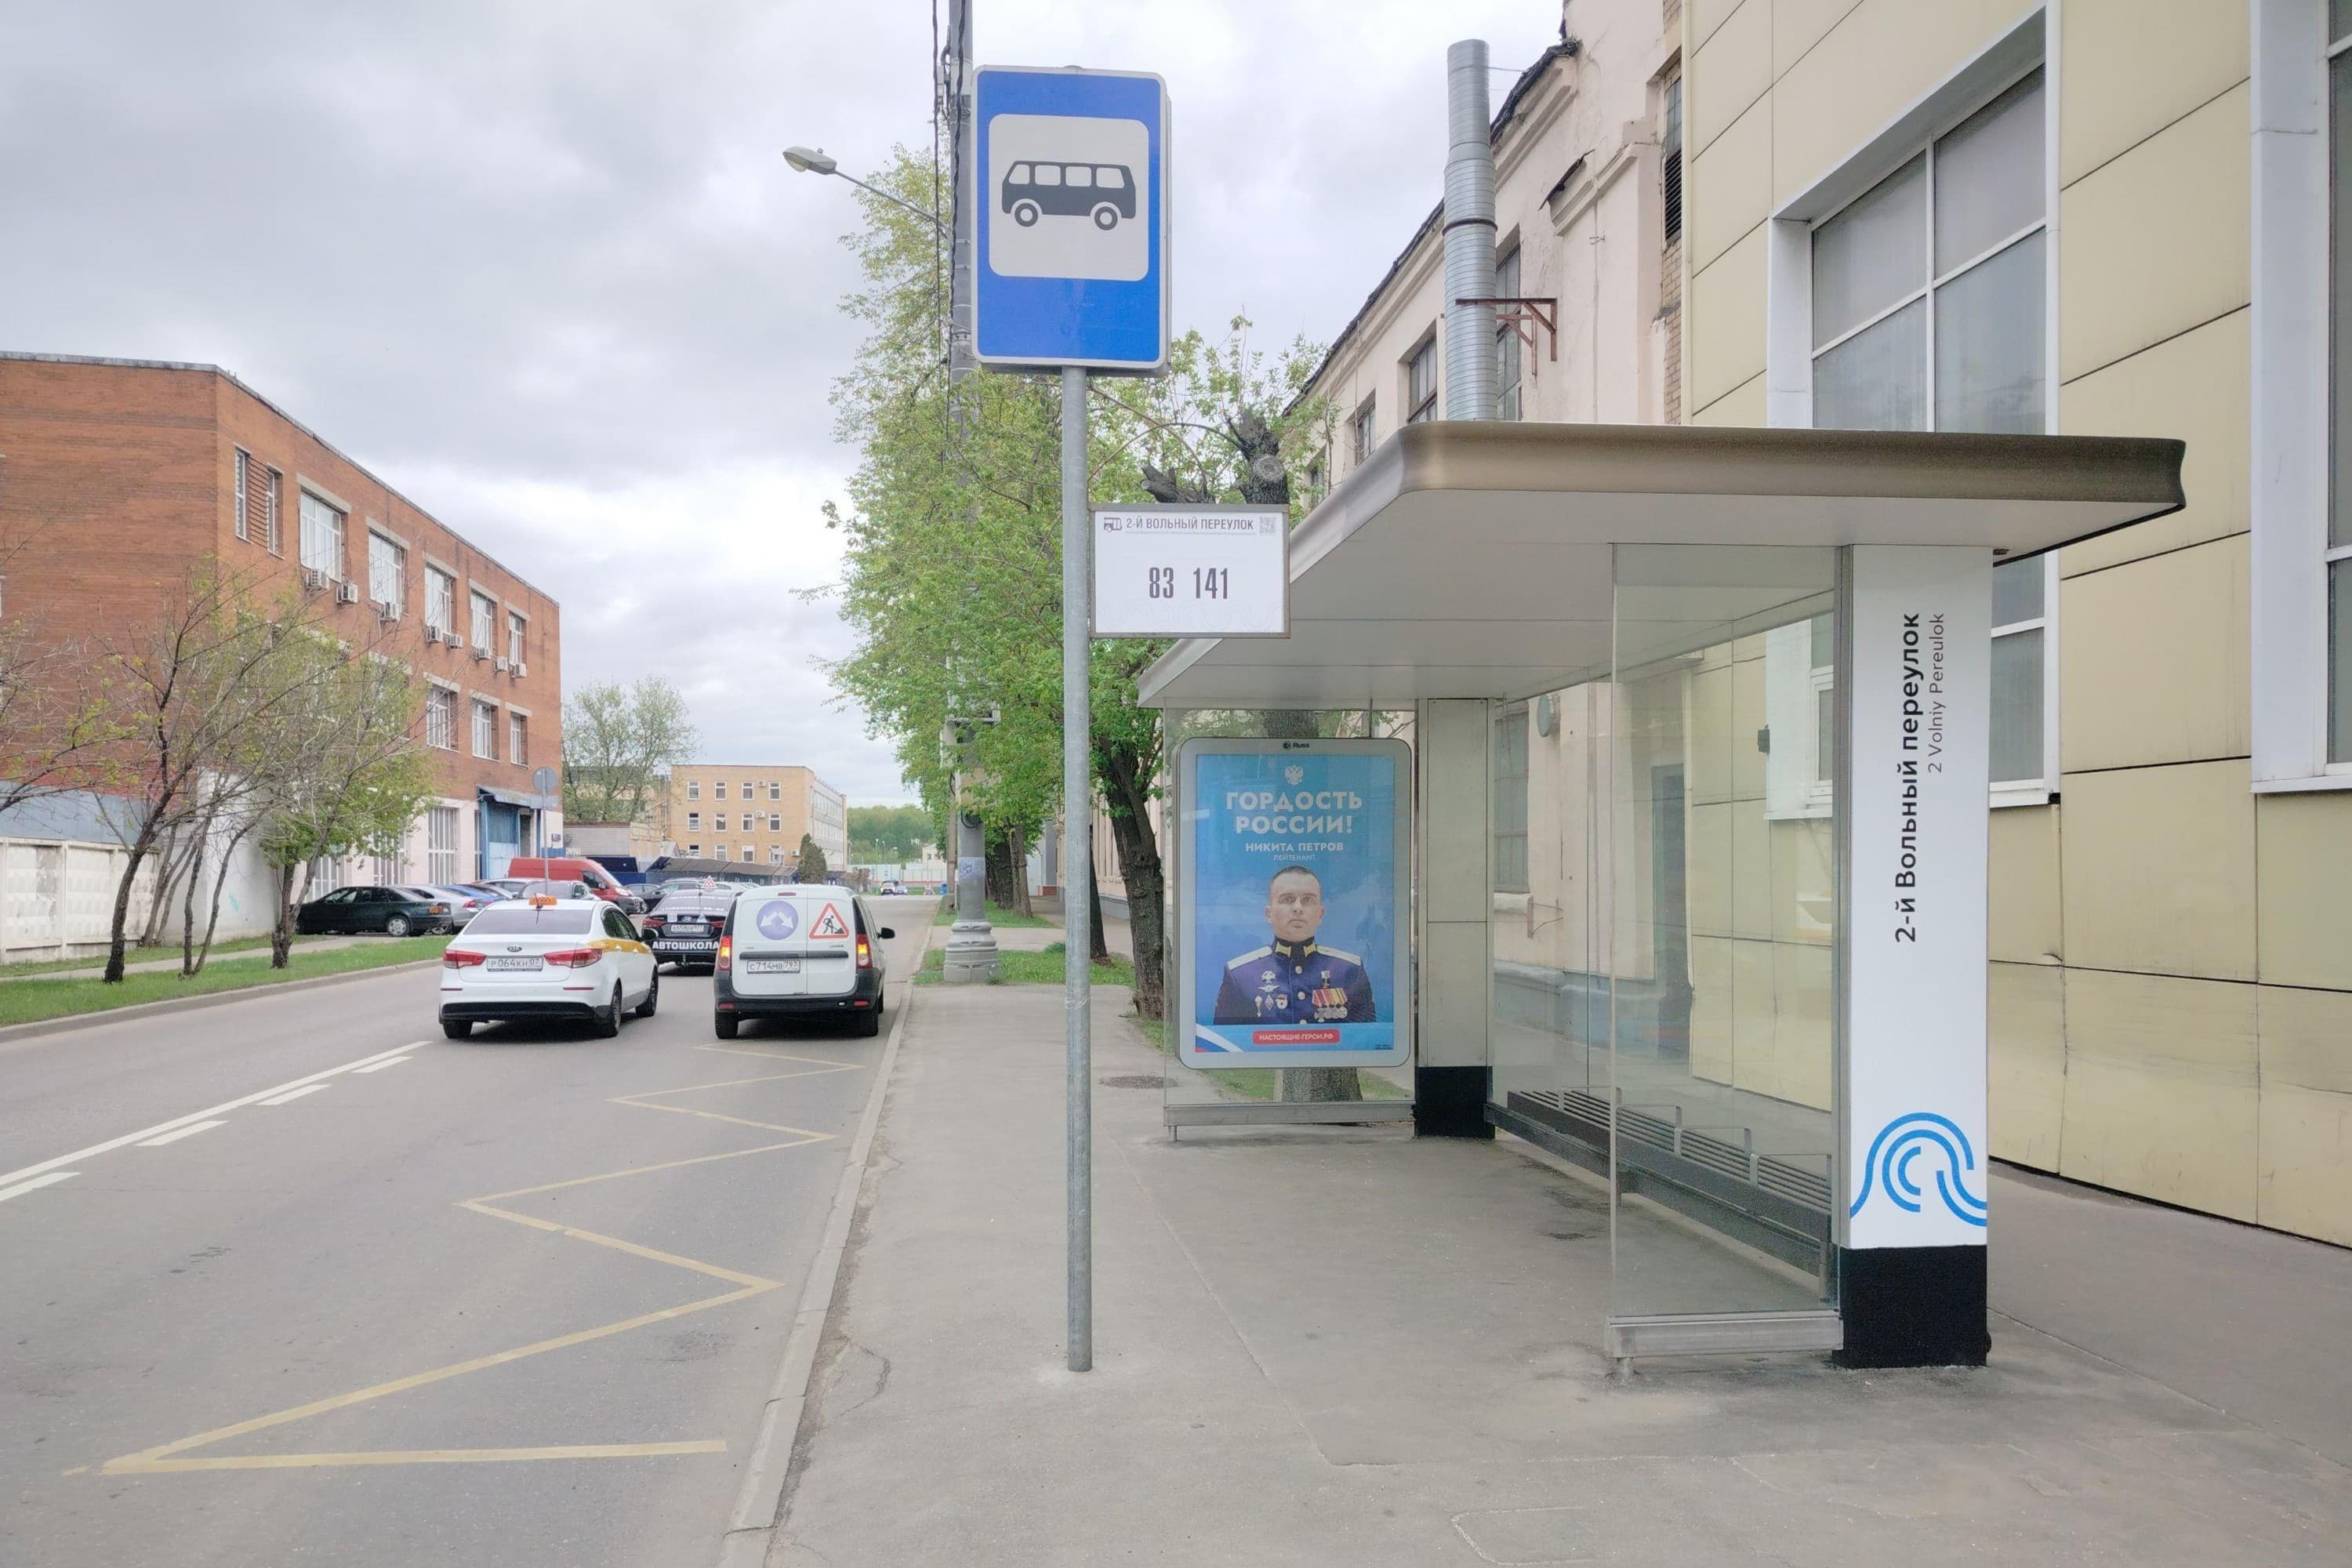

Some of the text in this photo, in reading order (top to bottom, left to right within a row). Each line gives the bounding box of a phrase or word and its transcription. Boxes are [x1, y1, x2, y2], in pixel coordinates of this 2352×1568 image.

[1126, 515, 1254, 530] 2-Й ВОЛЬНЫЙ ПЕРЕУЛОК
[1149, 567, 1229, 600] 83 141
[1927, 613, 1947, 773] 2 Volniy Pereulok
[1894, 613, 1924, 943] 2-й Вольный переулок
[1226, 791, 1363, 812] ГОРДОСТЬ
[1236, 815, 1352, 834] РОССИИ!
[1245, 842, 1344, 852] НИКИТА ПЕТРОВ
[652, 941, 720, 950] АВТОШКОЛА
